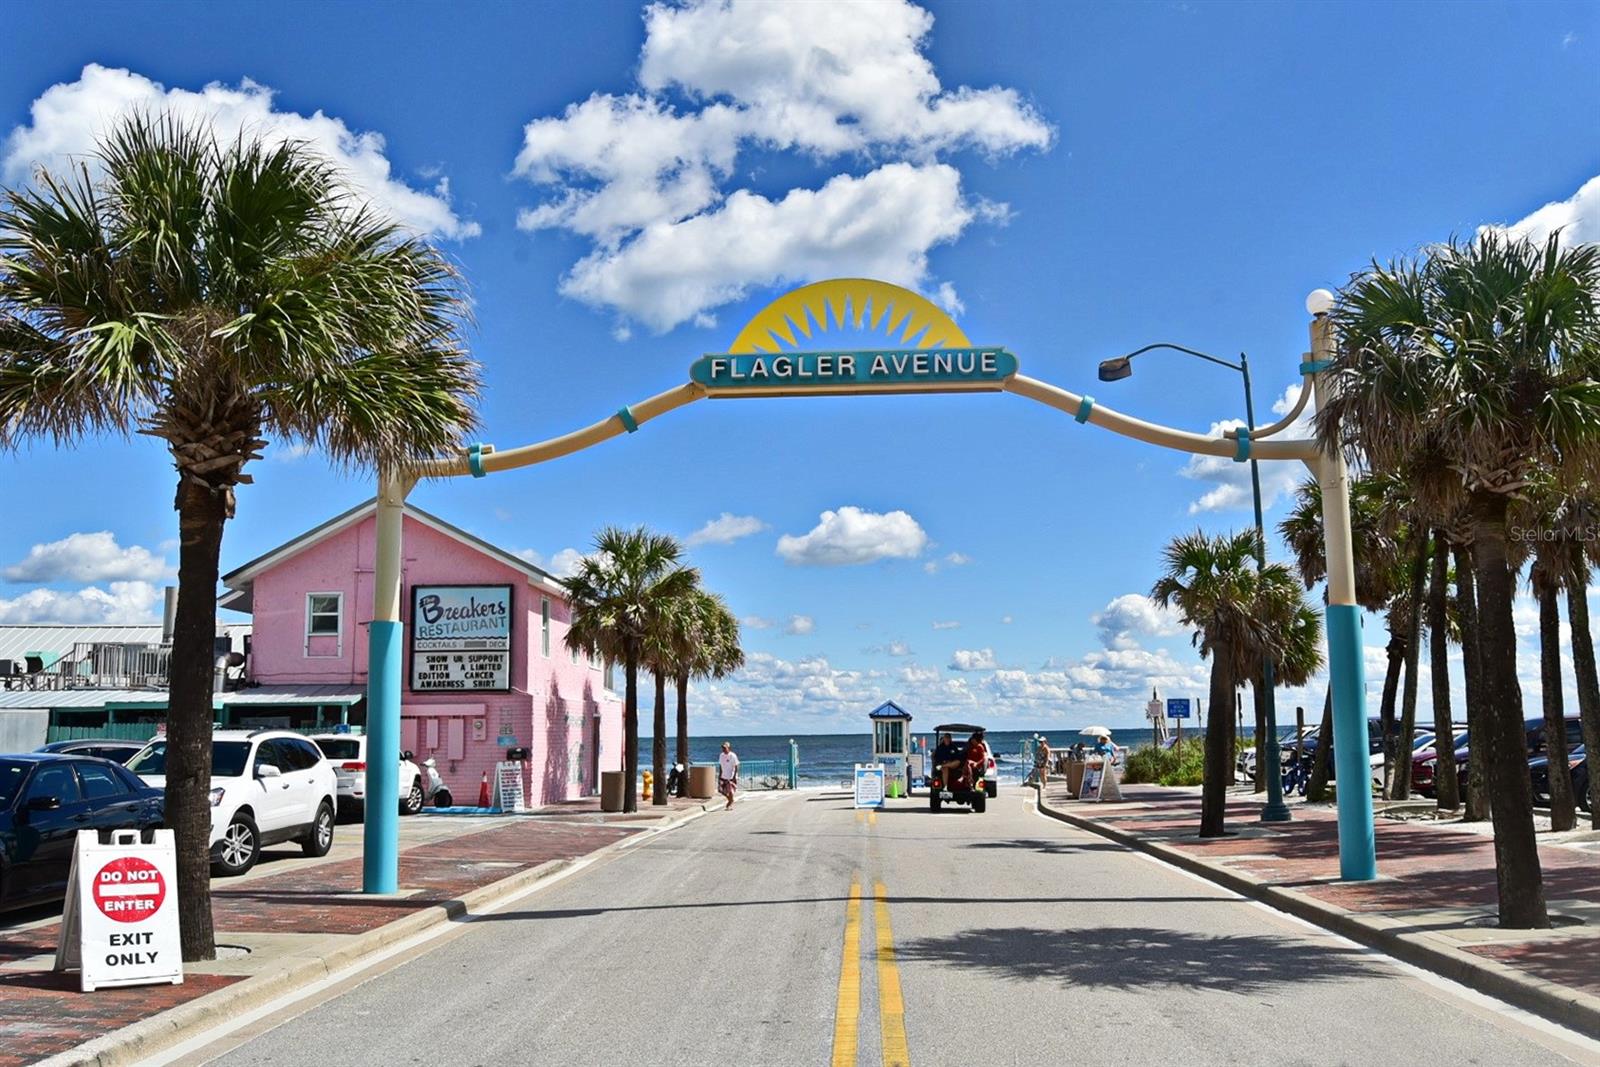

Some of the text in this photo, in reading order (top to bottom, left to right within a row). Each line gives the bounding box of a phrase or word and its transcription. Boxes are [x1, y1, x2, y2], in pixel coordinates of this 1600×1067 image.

[710, 352, 998, 379] FLAGLER AVENUE
[419, 594, 506, 624] Breakers
[419, 616, 507, 637] RESTAURANT
[426, 655, 504, 663] SHOW UR SUPPORT
[429, 663, 449, 671] WITH
[470, 663, 502, 671] LIMITED
[418, 671, 494, 680] EDITION CANCER
[420, 680, 465, 688] AWARENESS
[100, 869, 158, 882] DO NOT
[104, 900, 155, 912] ENTER
[109, 932, 154, 946] EXIT
[105, 951, 159, 967] ONLY
